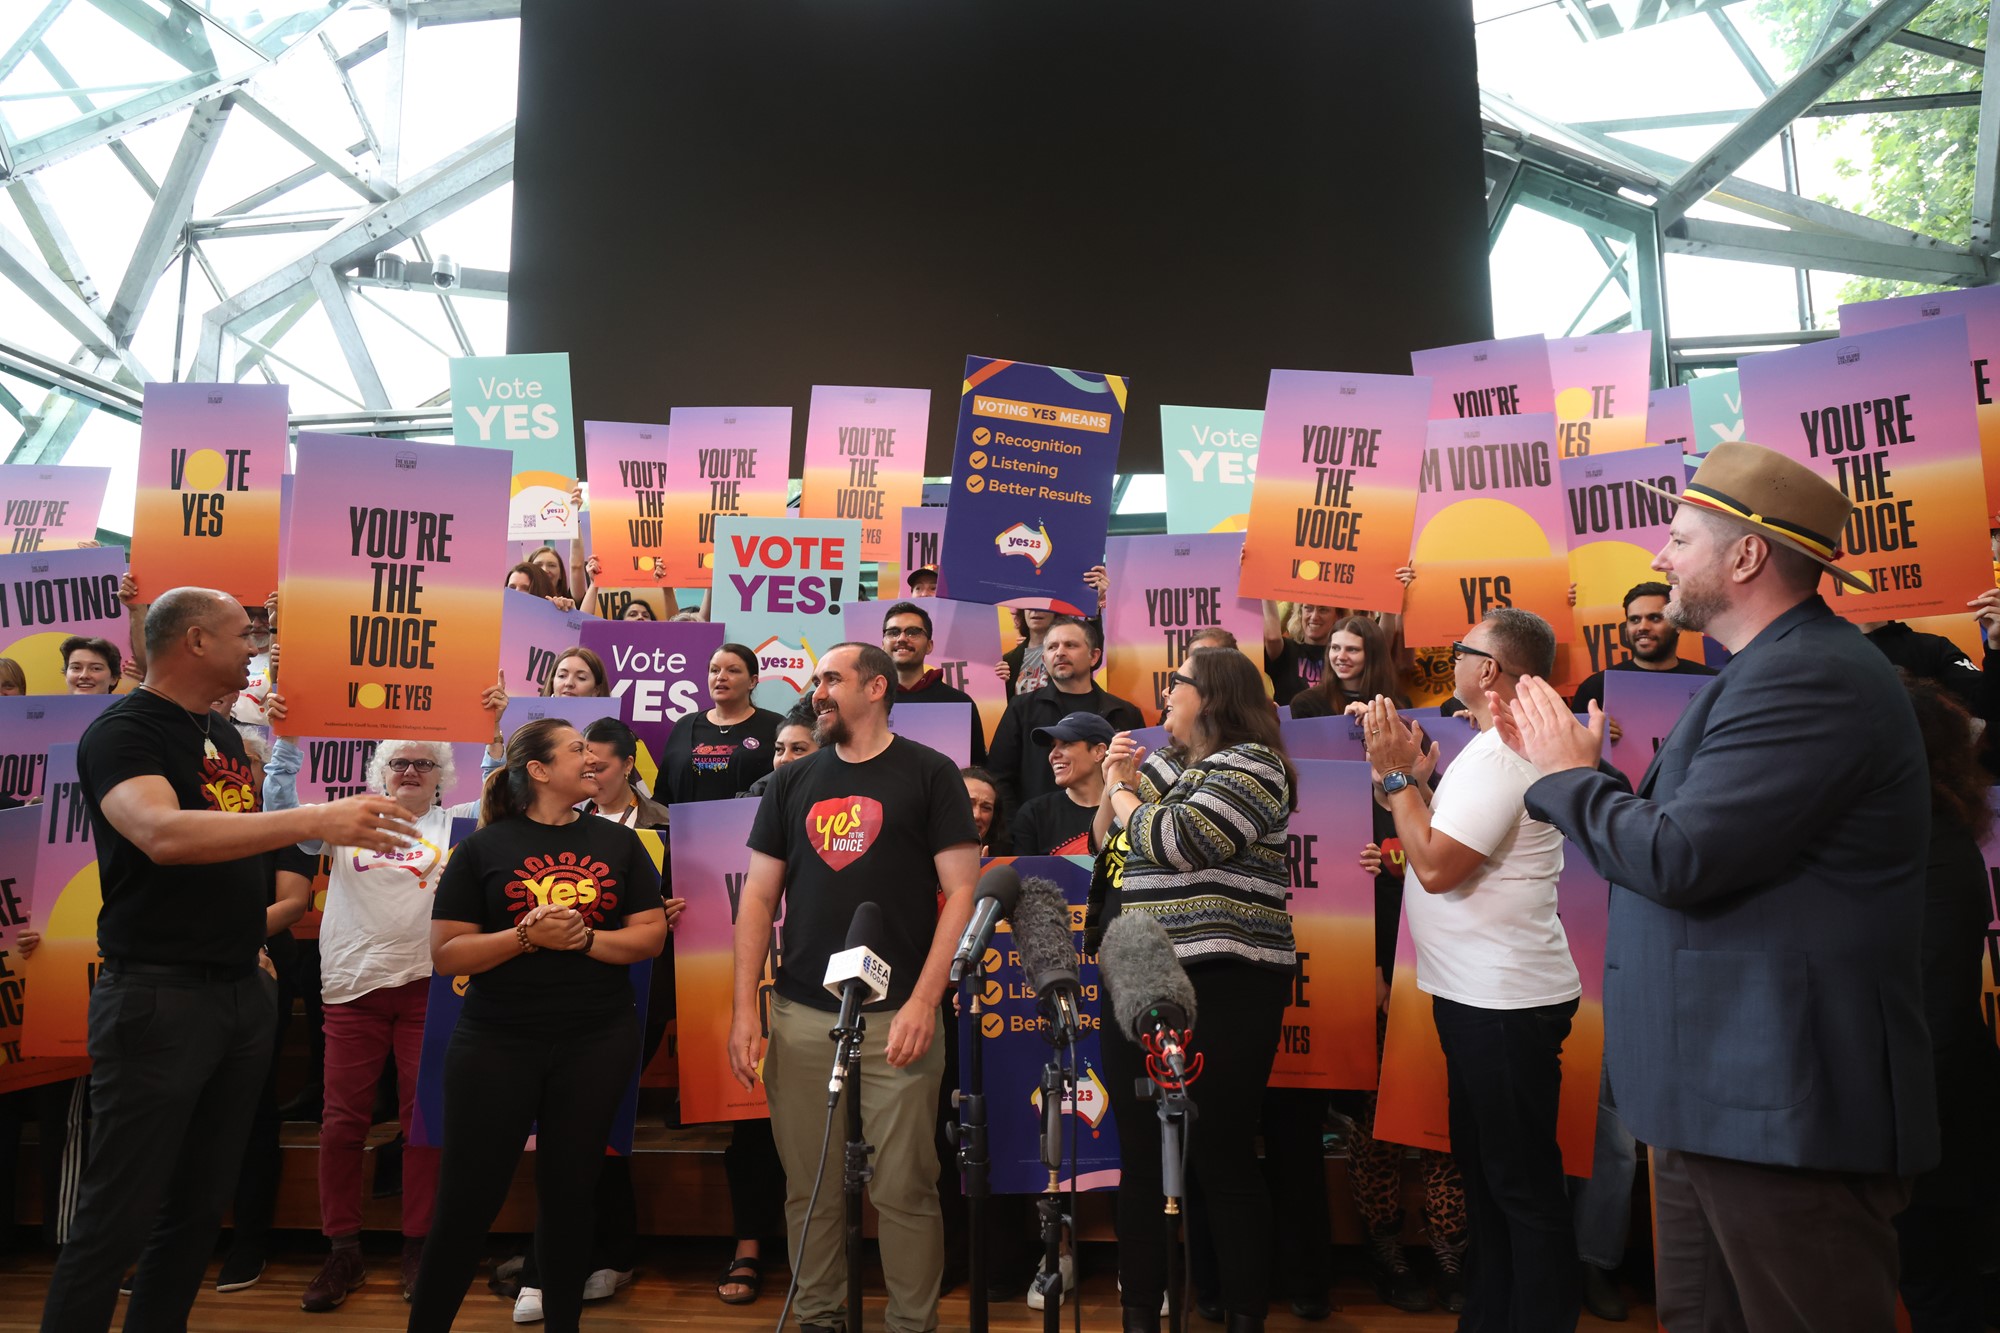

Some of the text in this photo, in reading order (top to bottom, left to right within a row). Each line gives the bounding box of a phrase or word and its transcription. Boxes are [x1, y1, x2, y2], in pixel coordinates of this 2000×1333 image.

[478, 377, 543, 400] Vote
[1453, 384, 1521, 418] YOU'RE
[465, 403, 560, 441] YES
[976, 400, 1107, 428] VOTING YES MEANS
[1801, 394, 1915, 458] YOU'RE
[838, 427, 896, 457] YOU'RE
[995, 432, 1082, 455] Recognition
[1192, 425, 1258, 449] Vote
[1303, 425, 1382, 468] YOU'RE
[619, 460, 667, 488] YOU'R
[699, 449, 757, 478] YOU'RE
[849, 459, 879, 487] THE
[991, 456, 1059, 478] Listening
[1447, 441, 1551, 491] VOTING
[1832, 451, 1893, 503] THE
[711, 481, 741, 510] THE
[988, 479, 1092, 505] Better Results
[1314, 468, 1356, 508] THE
[4, 500, 69, 526] YOU'RE
[182, 493, 225, 537] YES
[836, 489, 885, 520] VOICE
[1568, 475, 1677, 535] VOTING
[11, 528, 46, 554] THE
[350, 506, 454, 563] YOU'RE
[628, 519, 663, 547] VOI
[866, 529, 882, 544] YES
[1008, 536, 1041, 549] yes23
[1295, 508, 1362, 552] VOICE
[1841, 500, 1918, 556] OICE
[731, 535, 845, 570] VOTE
[371, 562, 424, 614] THE
[1334, 562, 1355, 584] YES
[1891, 564, 1922, 590] YES
[14, 574, 122, 627] VOTING
[729, 574, 843, 615] YES!
[1146, 587, 1221, 627] YOU'RE
[1460, 575, 1513, 625] YES
[350, 615, 437, 669] VOICE
[1164, 629, 1203, 668] TH
[612, 645, 687, 673] Vote
[760, 657, 804, 671] yes23
[405, 685, 432, 711] YES
[309, 741, 383, 784] YOU'R
[206, 780, 254, 813] Yes
[817, 804, 861, 850] yes
[832, 838, 863, 852] VOICE
[522, 876, 597, 907] Yes
[869, 970, 888, 989] TODAY
[871, 959, 889, 981] SEA
[1283, 1025, 1310, 1054] YES
